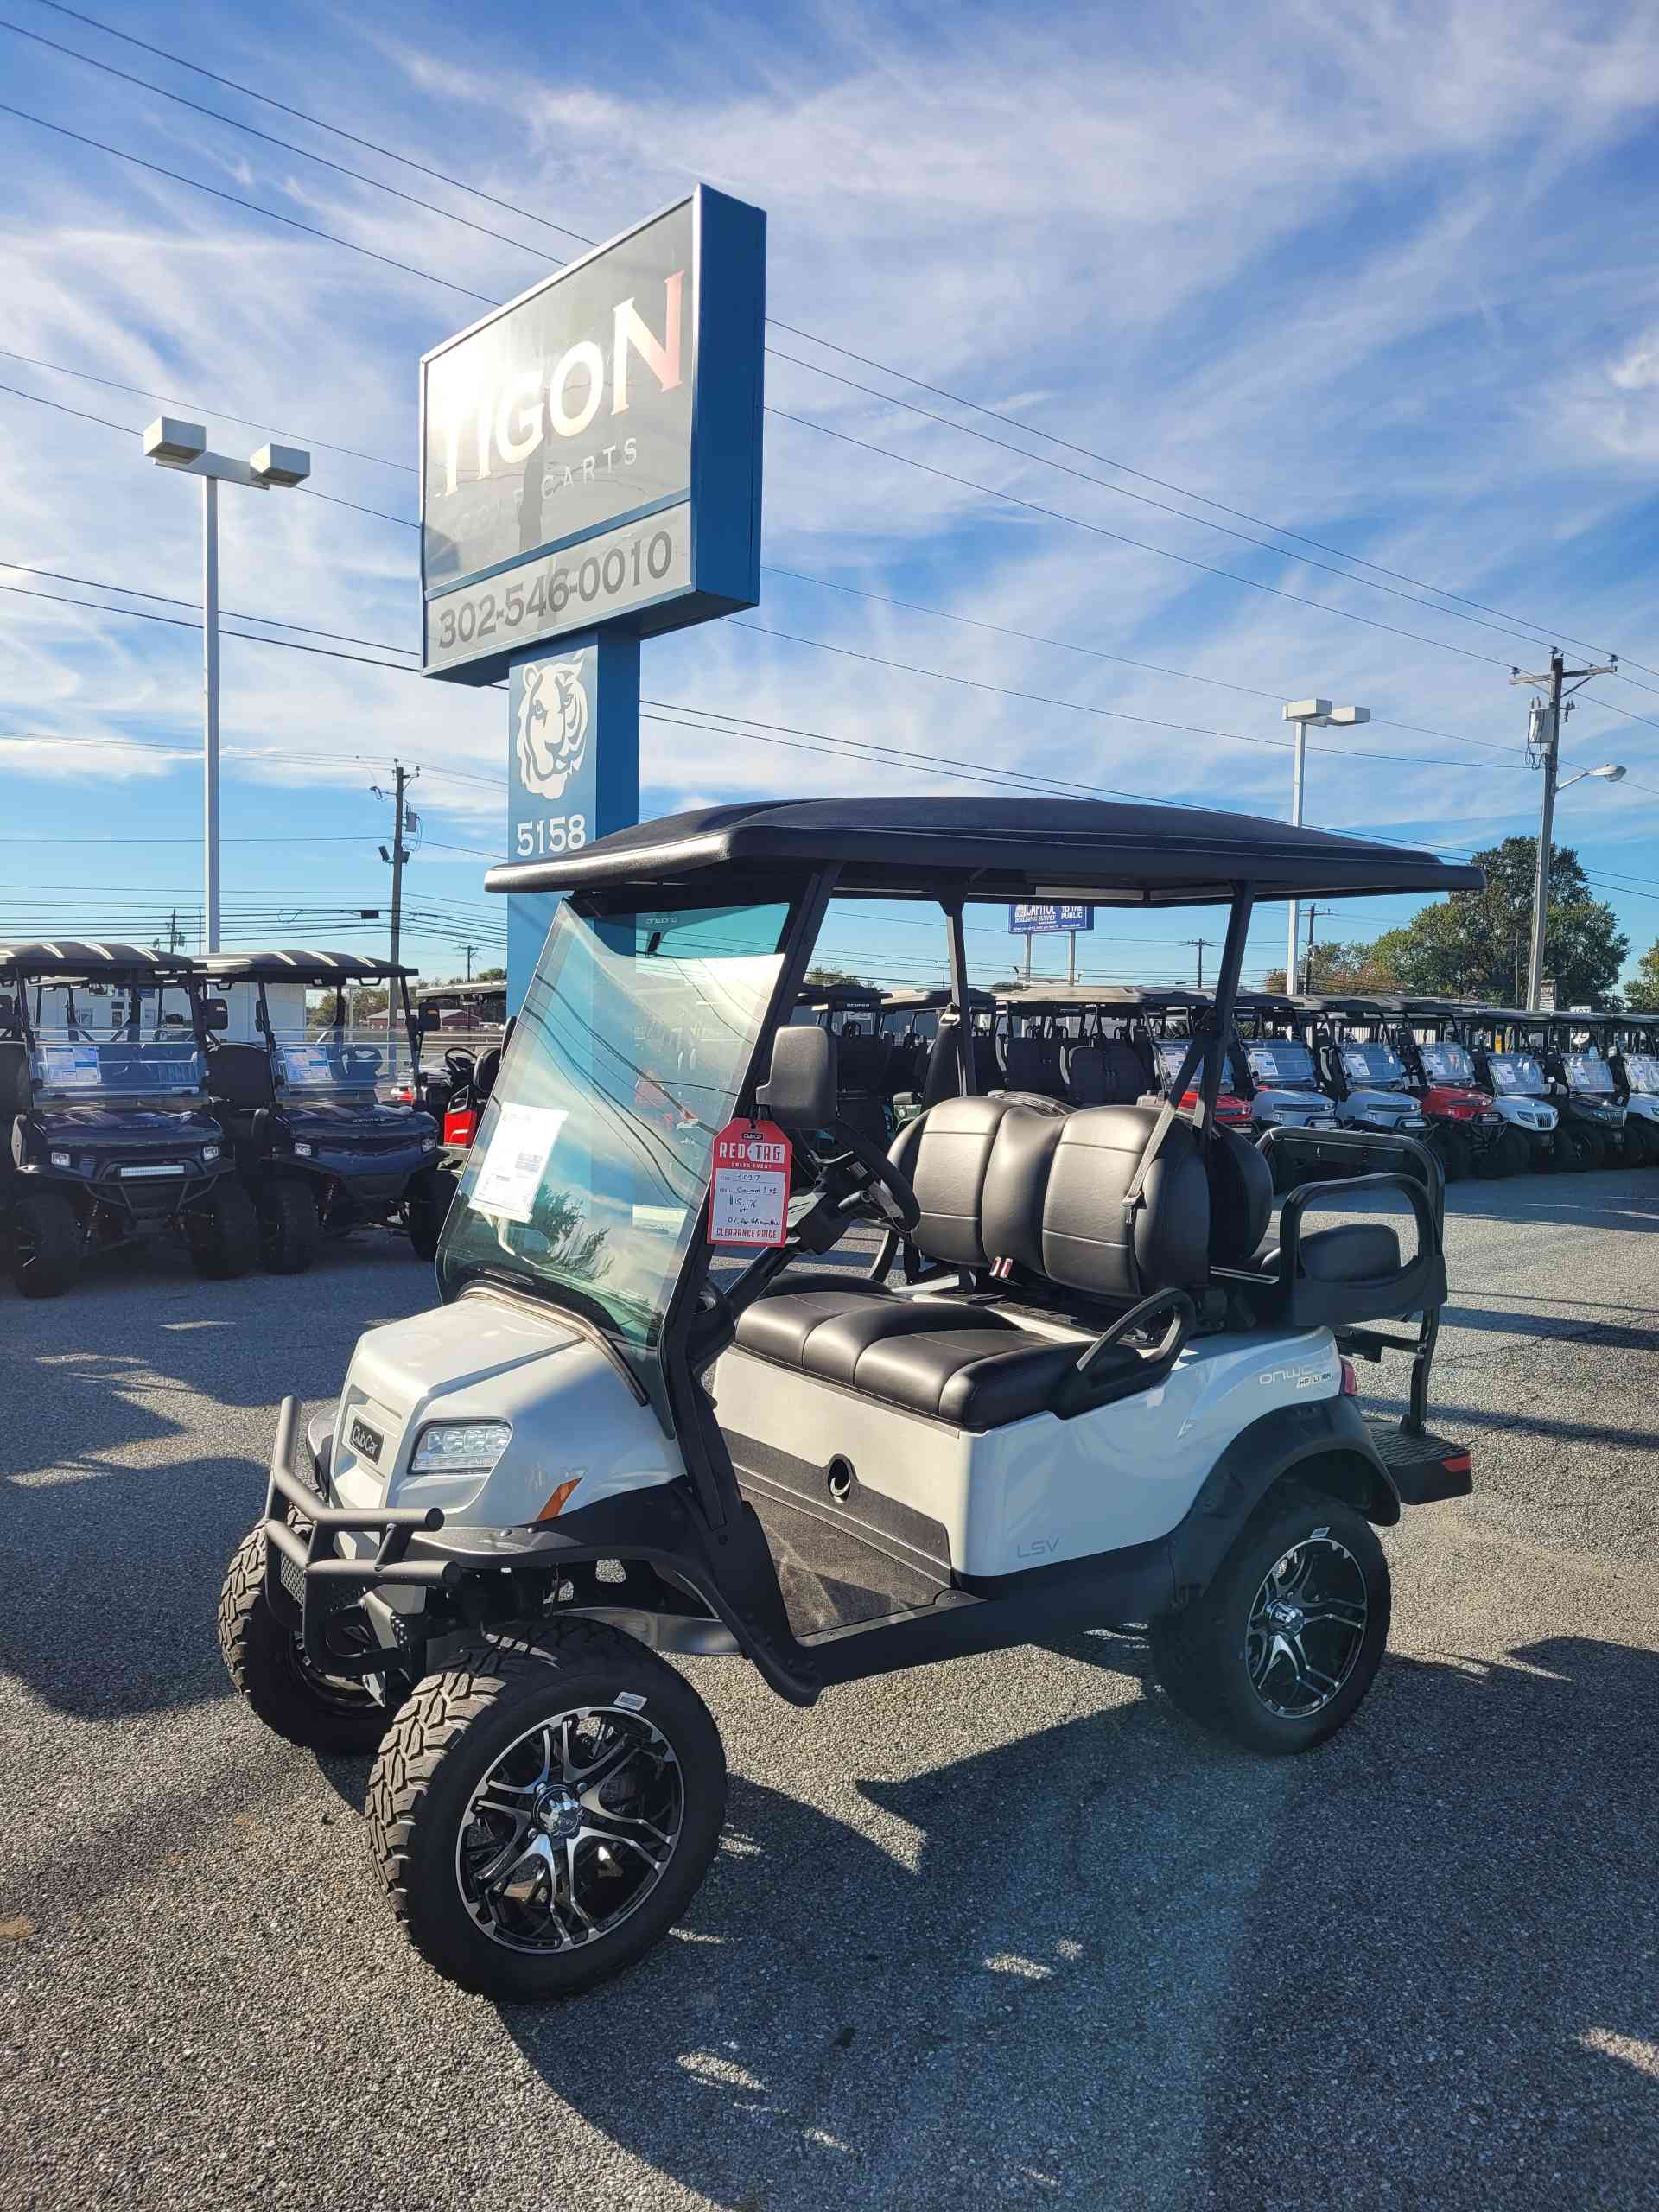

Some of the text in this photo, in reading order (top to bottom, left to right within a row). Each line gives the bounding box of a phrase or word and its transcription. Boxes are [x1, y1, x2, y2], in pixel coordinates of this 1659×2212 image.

[542, 437, 638, 500] CARTS
[438, 531, 672, 649] 302-546-0010
[517, 814, 587, 857] 5158
[1061, 912, 1083, 920] PUBLIC
[719, 1141, 781, 1162] RED TAG
[716, 1227, 777, 1239] CLEARANCE PRICE
[353, 1425, 378, 1455] Club Car
[1016, 1536, 1059, 1559] LSV
